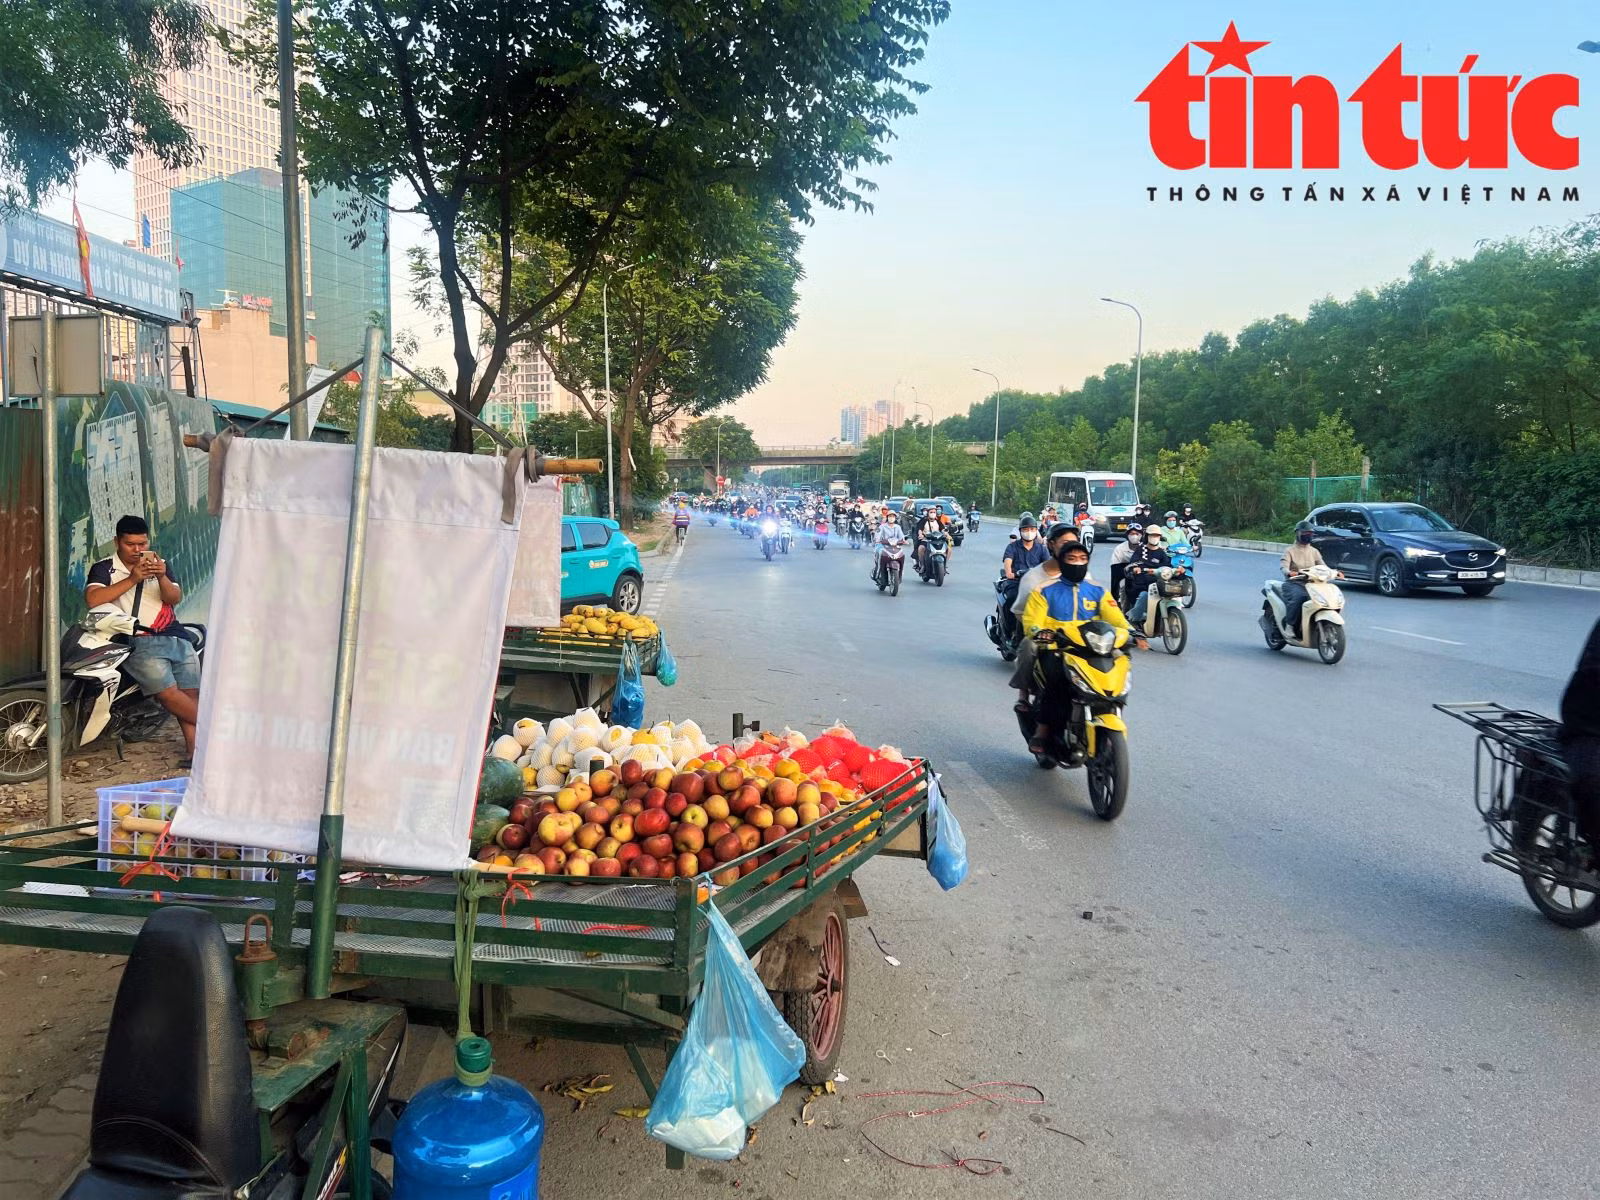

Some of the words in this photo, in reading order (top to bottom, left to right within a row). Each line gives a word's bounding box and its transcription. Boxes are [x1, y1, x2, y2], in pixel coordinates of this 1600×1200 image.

[13, 238, 30, 270] DỰ
[32, 241, 47, 272] ÁN
[113, 267, 129, 297] TÂY
[130, 277, 150, 304] NAM
